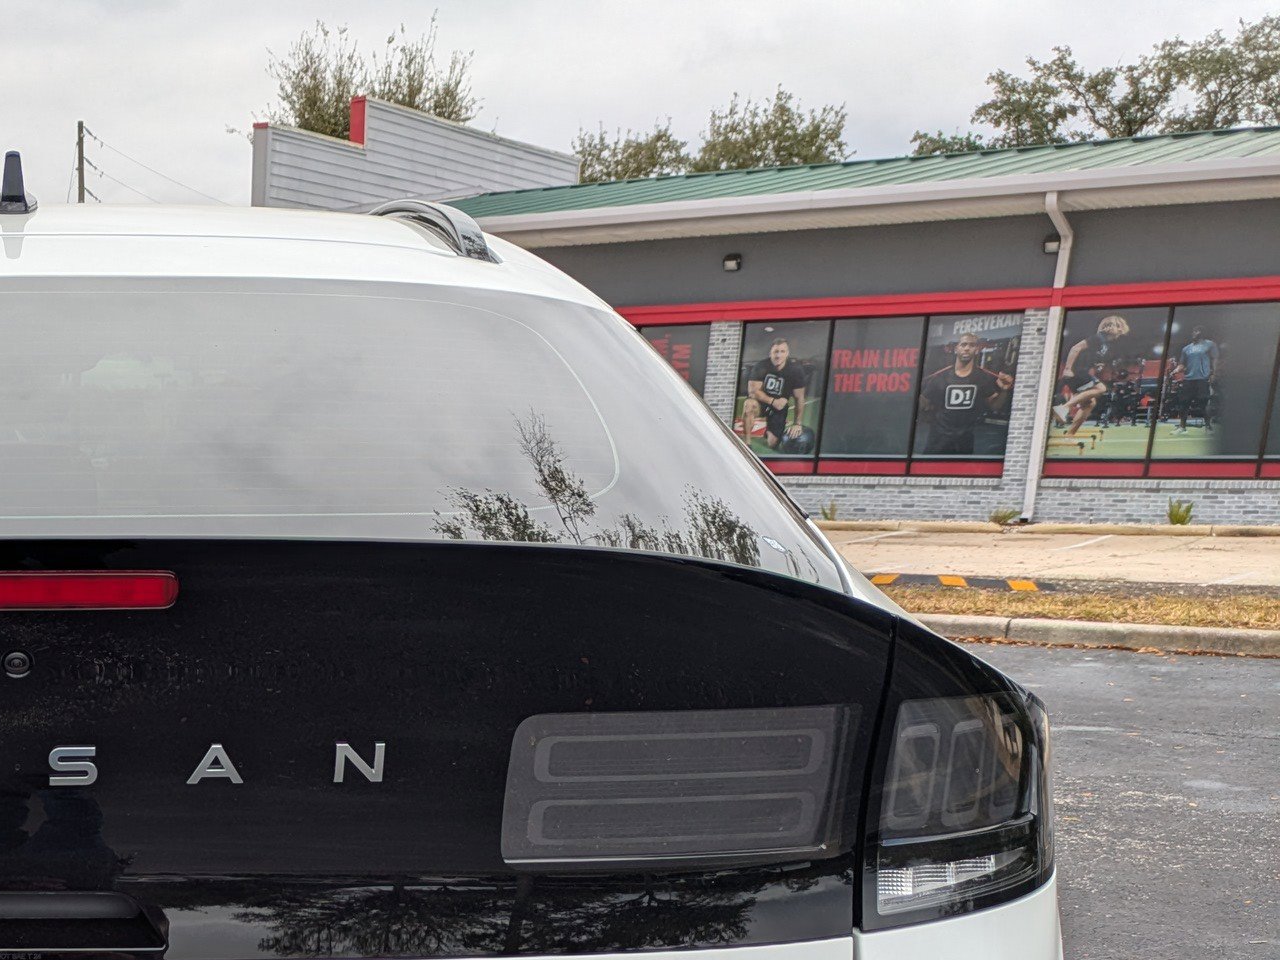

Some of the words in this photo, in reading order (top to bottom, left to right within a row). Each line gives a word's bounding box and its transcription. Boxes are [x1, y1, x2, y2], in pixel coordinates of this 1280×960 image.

[832, 348, 879, 369] TRAIN
[884, 347, 919, 368] LIKE
[834, 373, 863, 393] THE
[866, 372, 911, 393] PROS
[950, 389, 971, 404] D1
